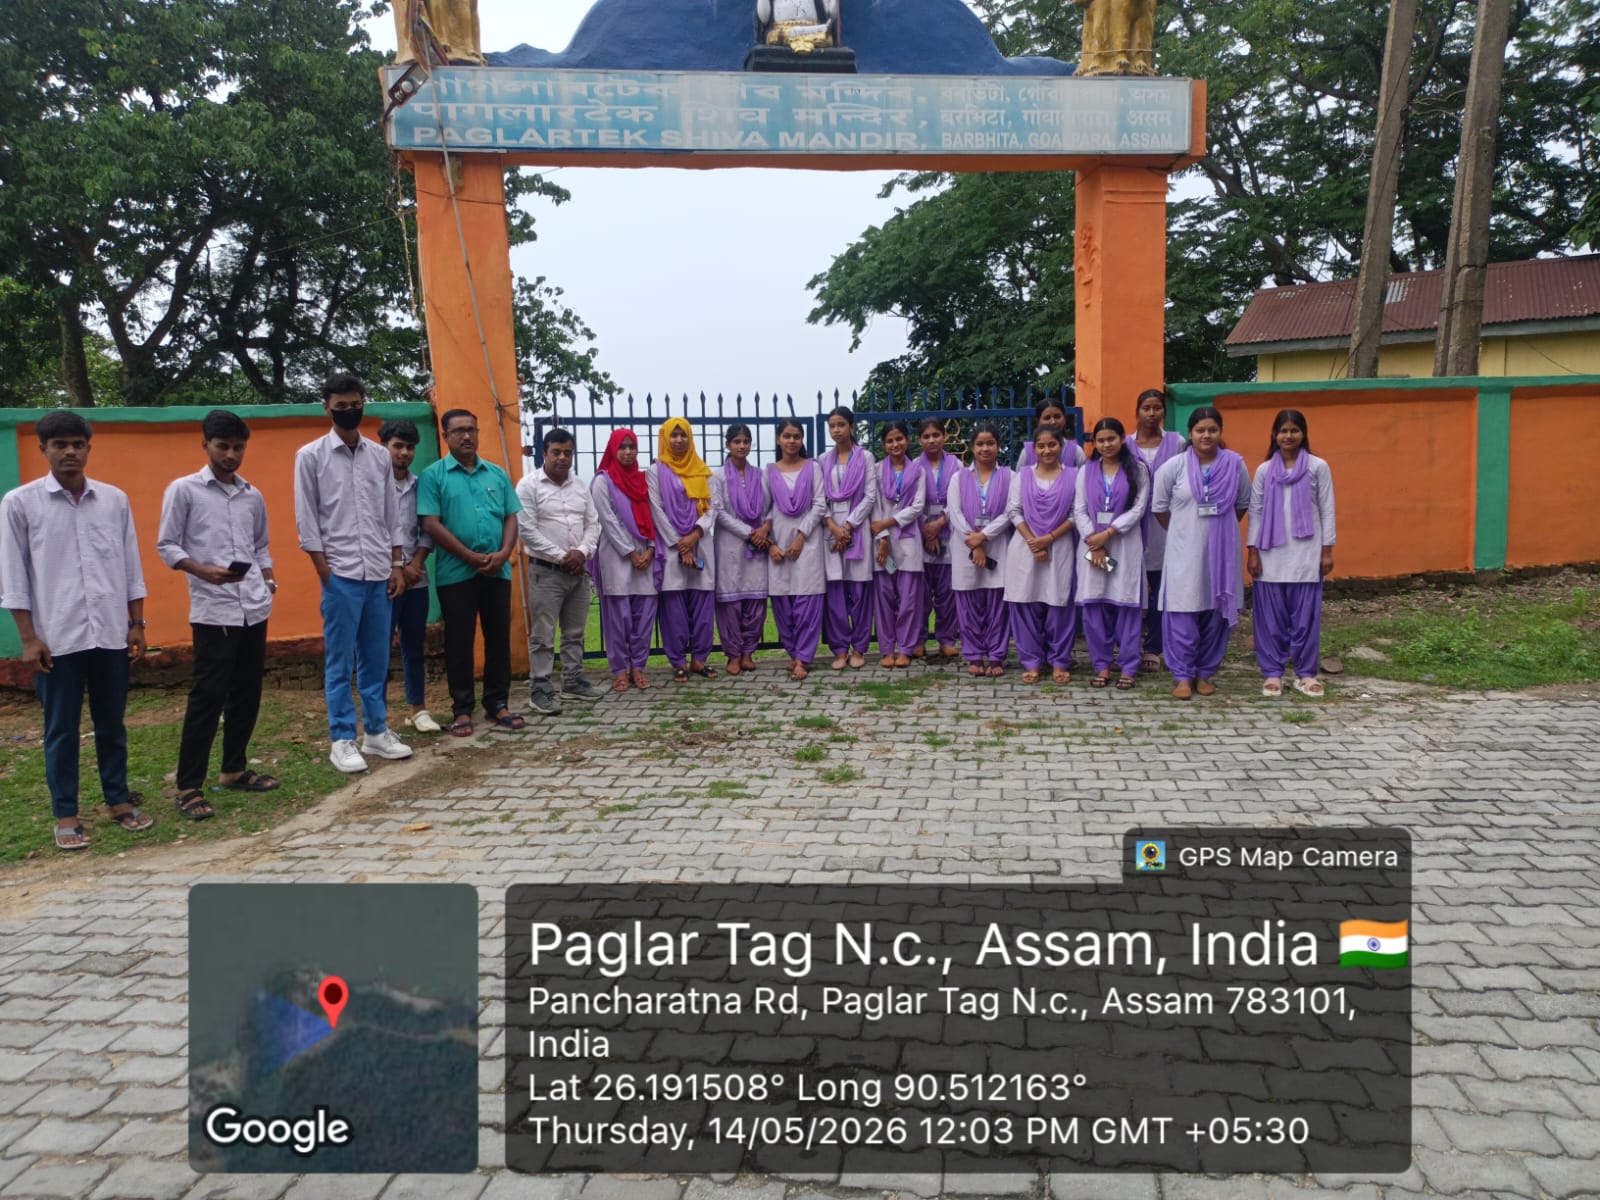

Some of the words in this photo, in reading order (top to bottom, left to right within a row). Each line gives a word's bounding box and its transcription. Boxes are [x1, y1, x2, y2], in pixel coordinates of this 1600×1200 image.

[410, 98, 658, 122] पागलारटेक
[1127, 109, 1172, 128] असम
[413, 127, 649, 146] PAGLARTEK
[660, 129, 769, 147] SHIVA
[1119, 132, 1173, 148] ASSAM
